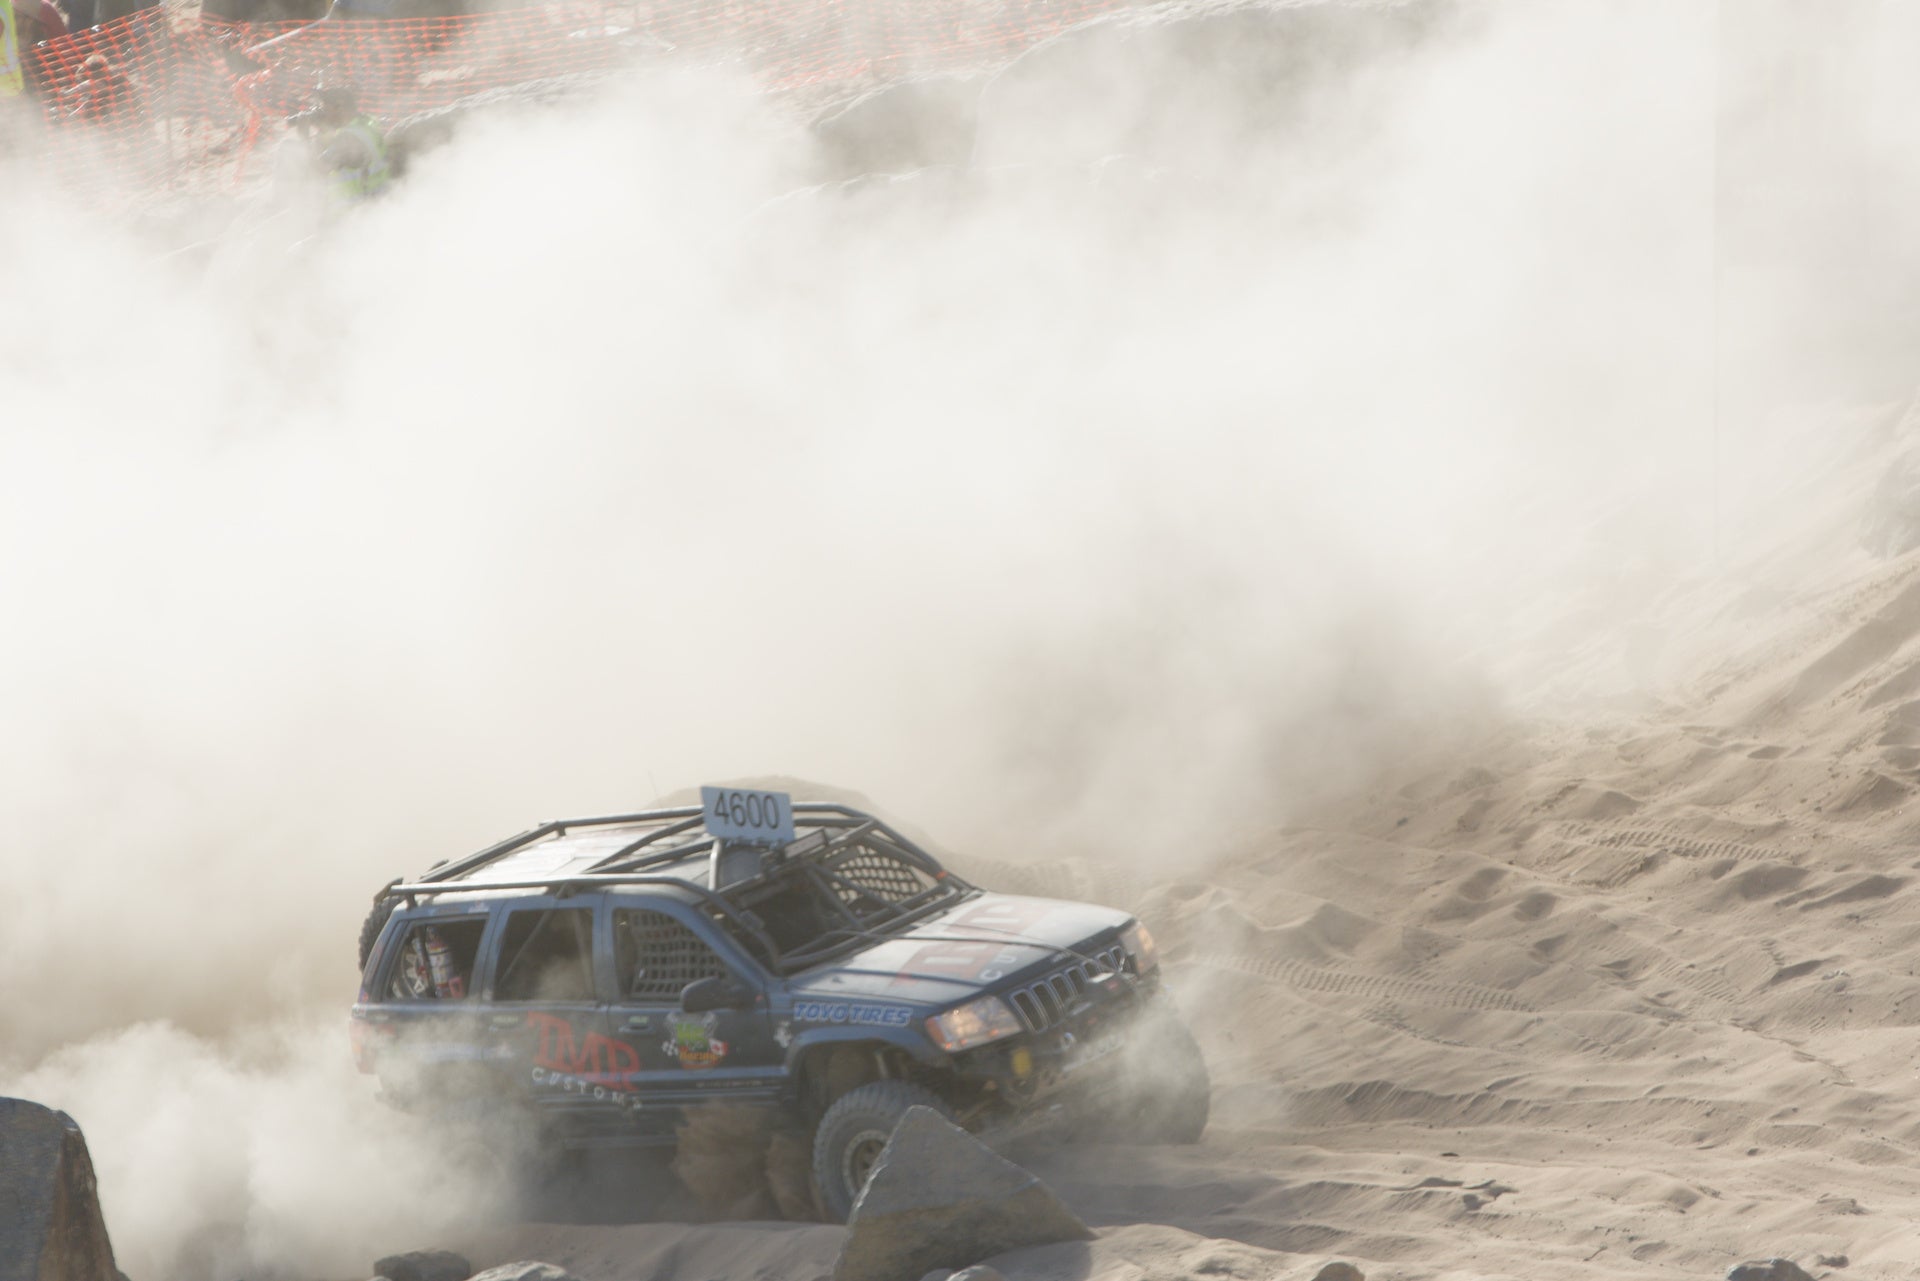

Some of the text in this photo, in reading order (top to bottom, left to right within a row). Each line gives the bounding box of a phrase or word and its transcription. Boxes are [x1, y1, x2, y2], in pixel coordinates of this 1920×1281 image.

[714, 791, 779, 830] 4600
[795, 1002, 912, 1026] TOYO TIRES
[532, 1067, 643, 1110] CUSTOMS
